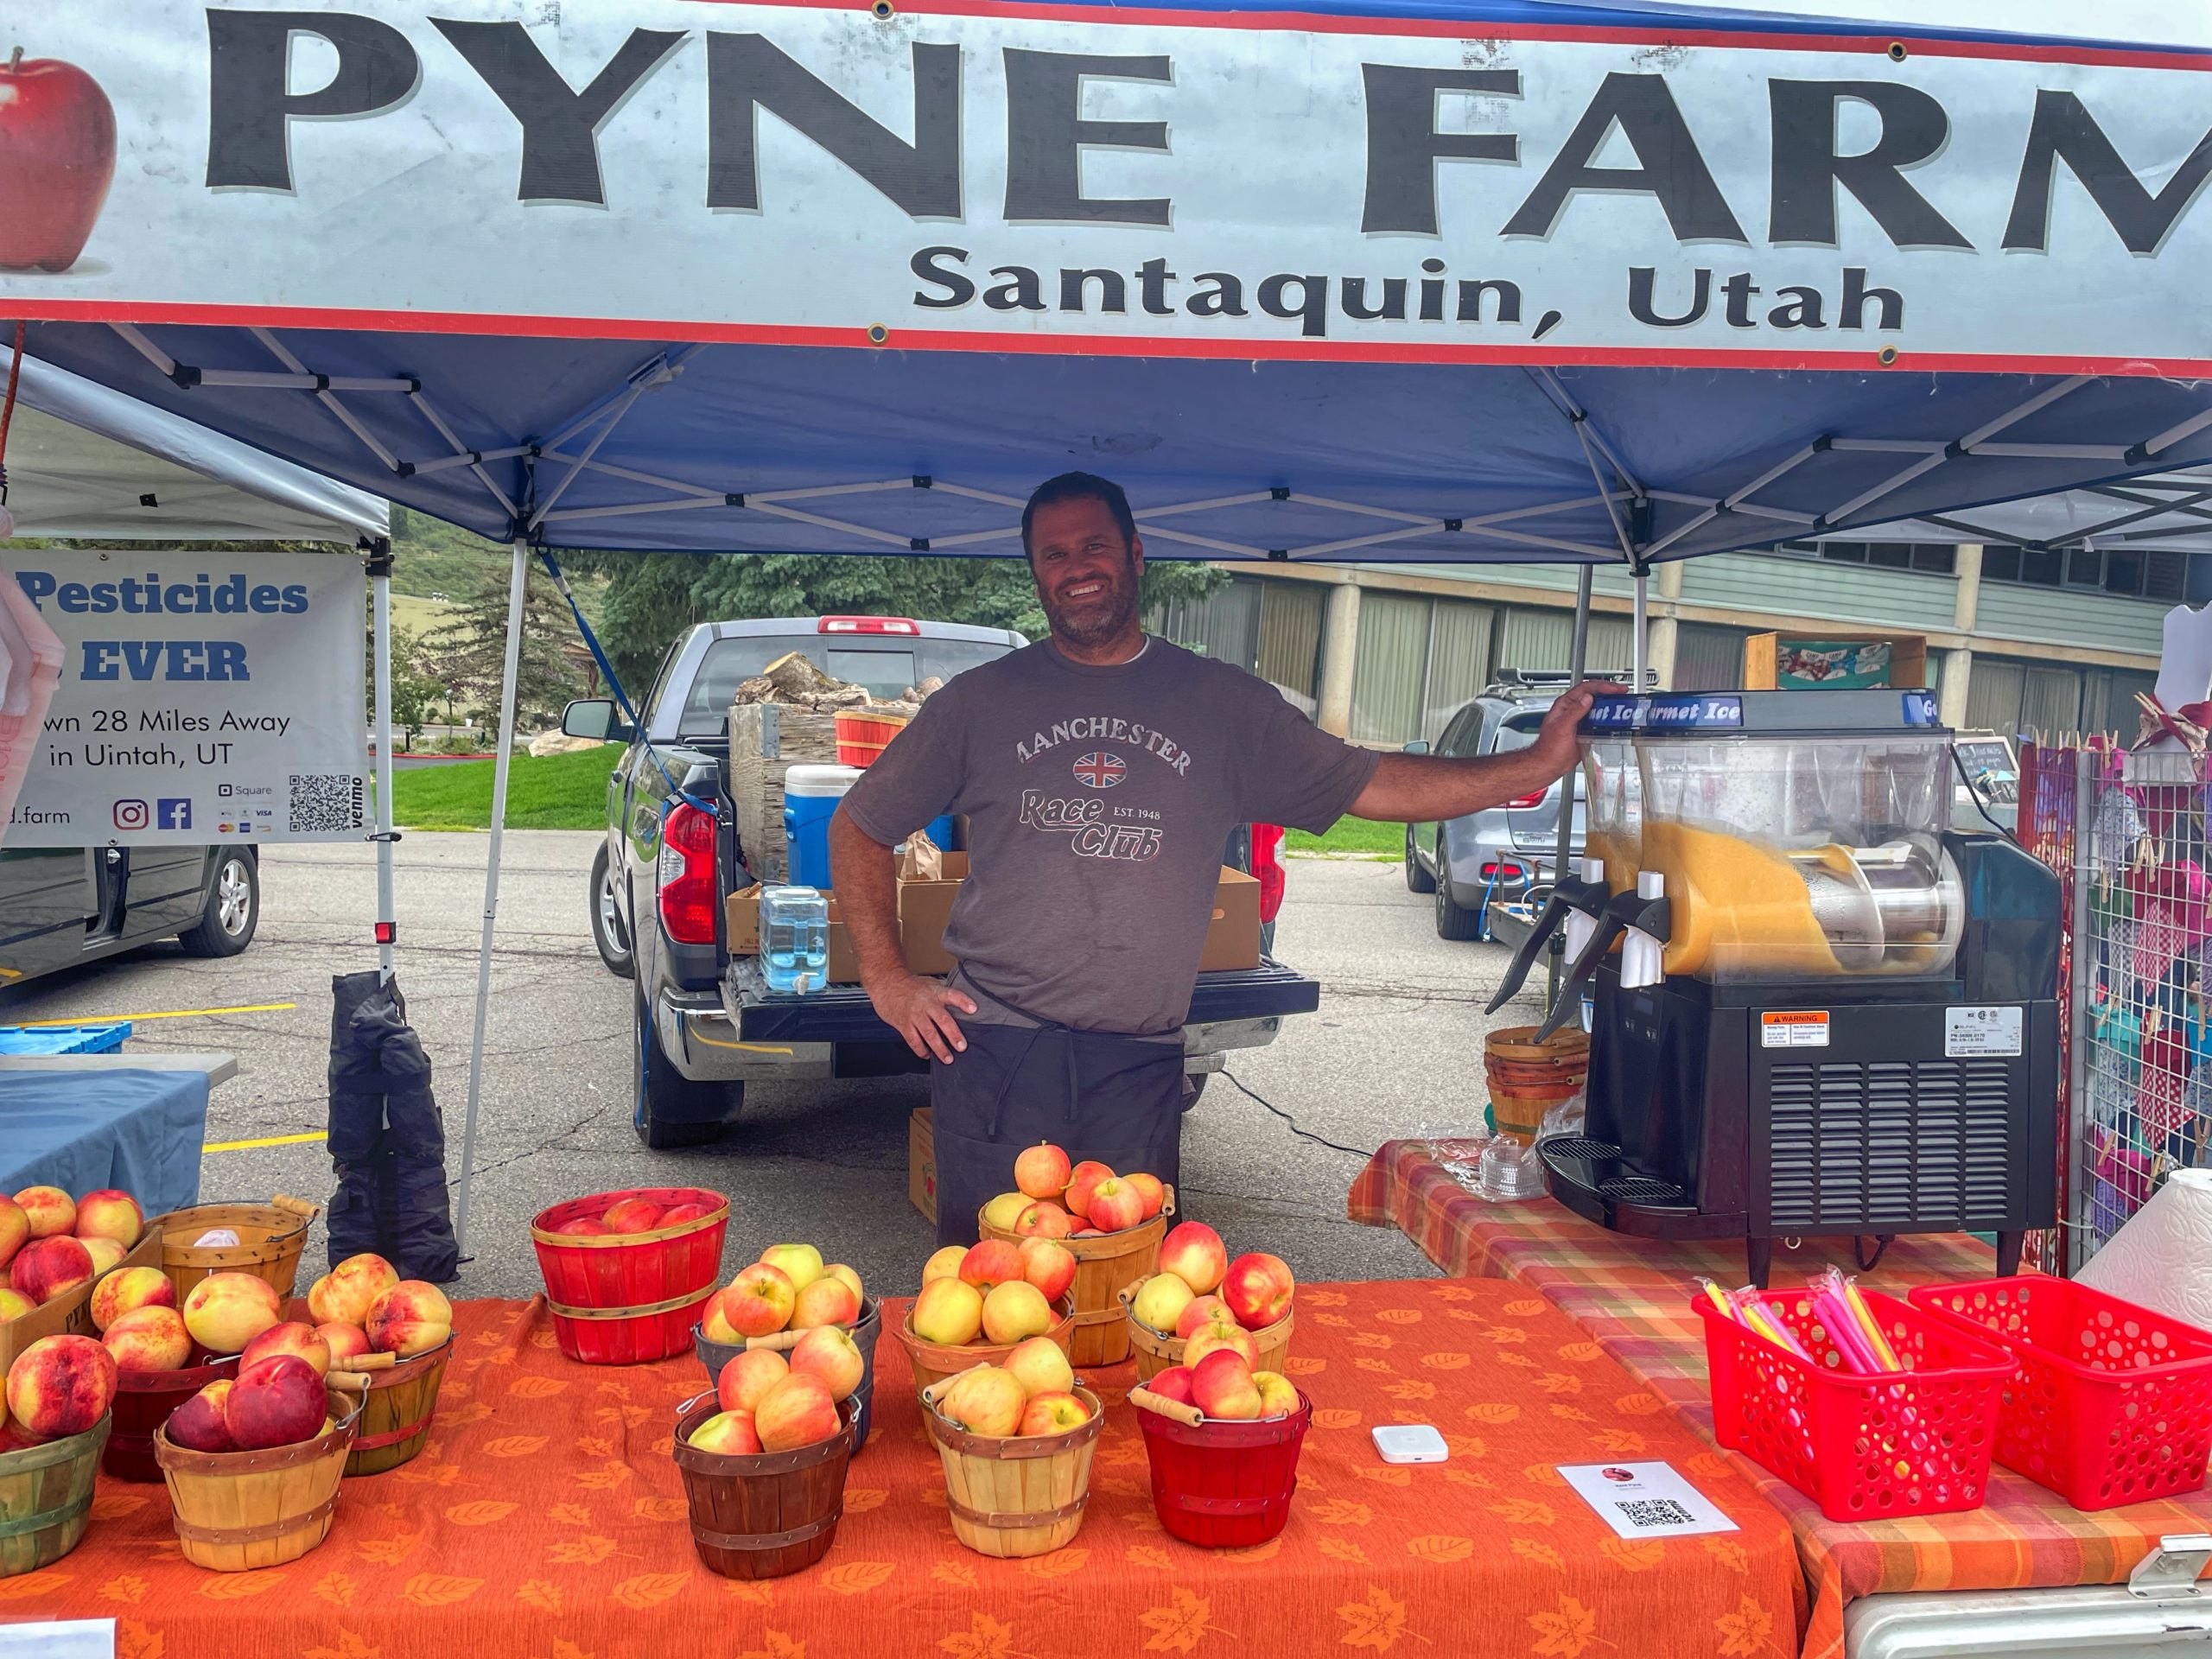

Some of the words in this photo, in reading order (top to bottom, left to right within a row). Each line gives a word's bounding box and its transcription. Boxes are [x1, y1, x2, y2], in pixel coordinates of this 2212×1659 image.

[206, 7, 1173, 230] PYNE
[910, 246, 1565, 340] Santaquin,
[1627, 266, 1906, 332] Utah
[15, 570, 309, 614] Pesticides
[79, 641, 251, 681] EVER
[92, 709, 128, 733] 28
[139, 709, 210, 732] Miles
[219, 710, 290, 736] Away
[1612, 704, 1643, 721] Ice
[1704, 702, 1740, 721] Ice
[49, 744, 73, 766] in
[85, 743, 186, 768] Uintah,
[197, 743, 233, 766] UT
[1015, 716, 1192, 776] MANCHESTER
[235, 785, 272, 797] Square
[352, 777, 363, 830] venmo
[1020, 789, 1104, 829] Race
[1114, 806, 1135, 817] EST.
[1138, 808, 1161, 821] 1948
[1072, 822, 1162, 861] Club
